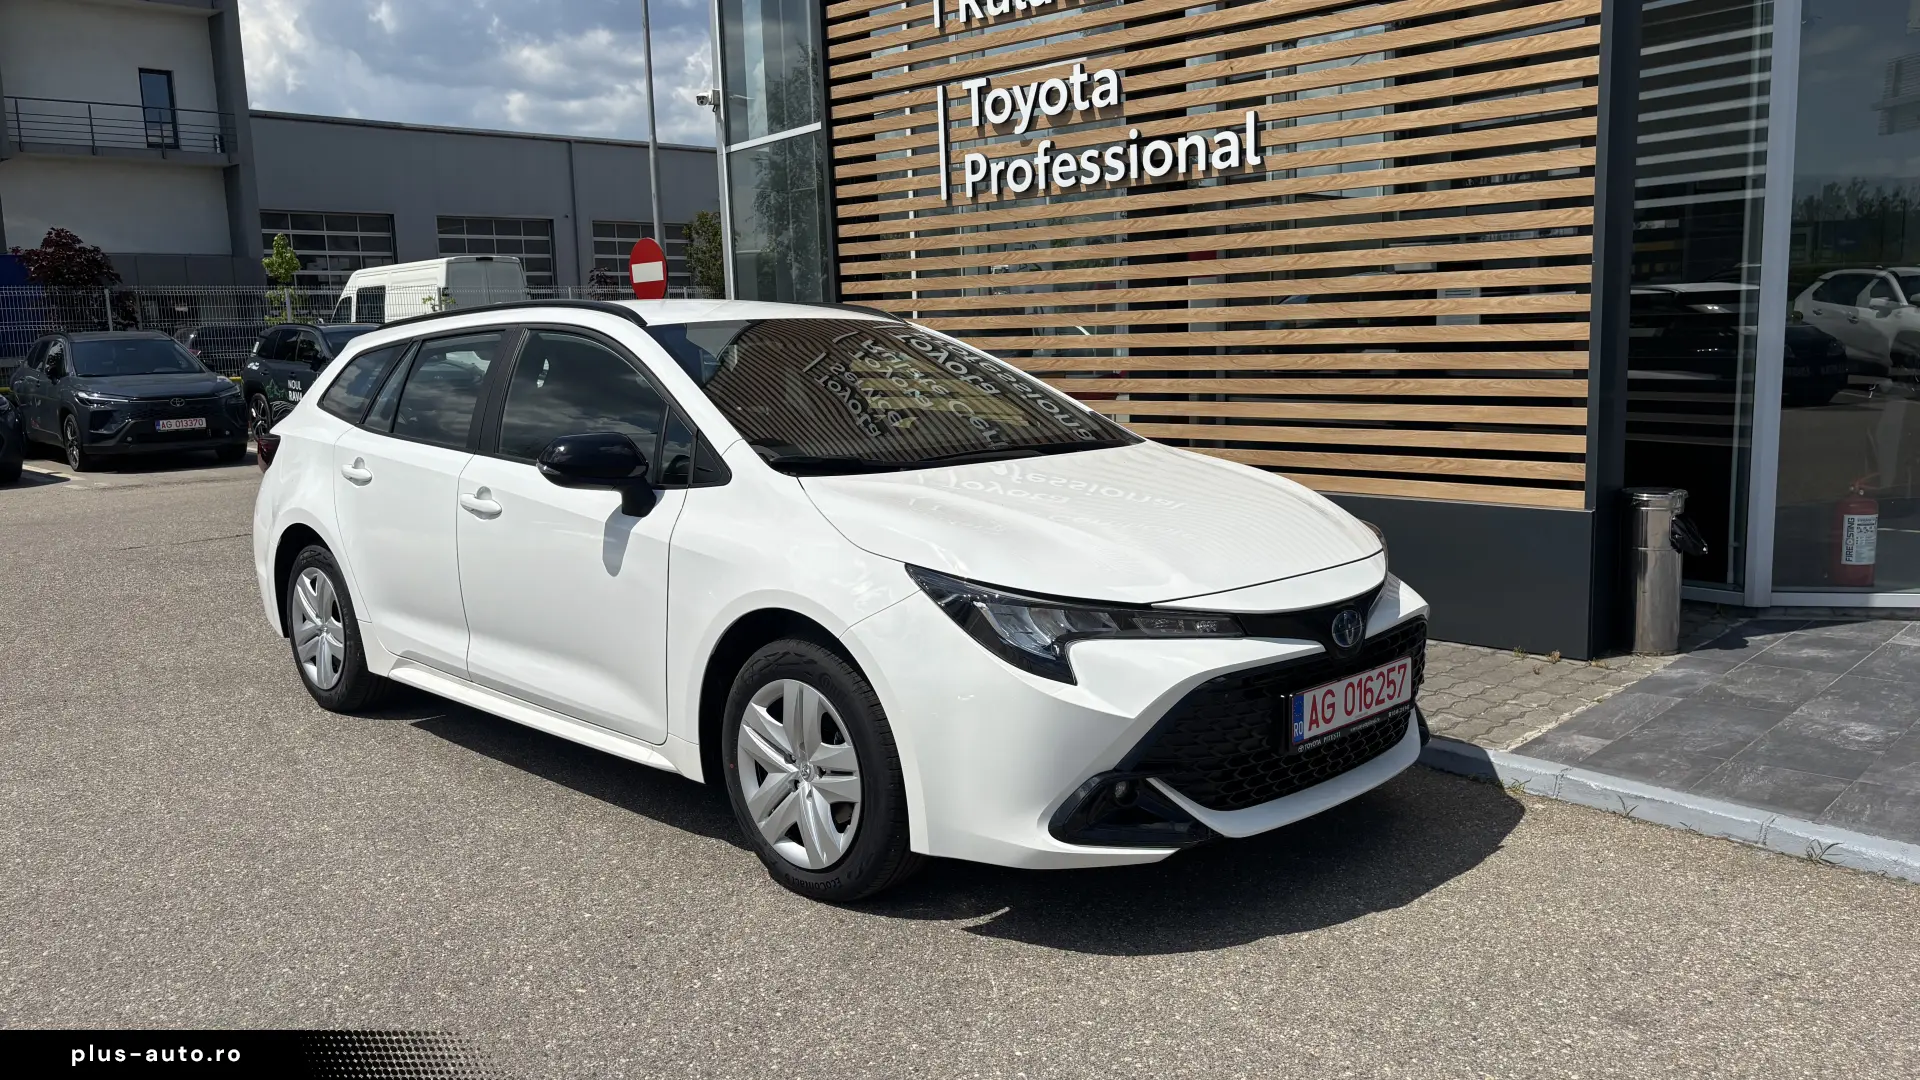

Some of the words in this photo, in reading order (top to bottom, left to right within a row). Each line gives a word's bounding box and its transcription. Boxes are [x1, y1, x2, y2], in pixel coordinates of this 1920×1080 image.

[962, 63, 1120, 134] Toyota
[965, 110, 1262, 198] Professional
[287, 379, 302, 391] NOUL
[161, 420, 172, 429] AG
[175, 418, 204, 428] 013370
[1308, 689, 1336, 732] AG
[1344, 663, 1407, 717] 016257
[1293, 721, 1304, 738] RO
[1304, 739, 1321, 750] TOYOTA
